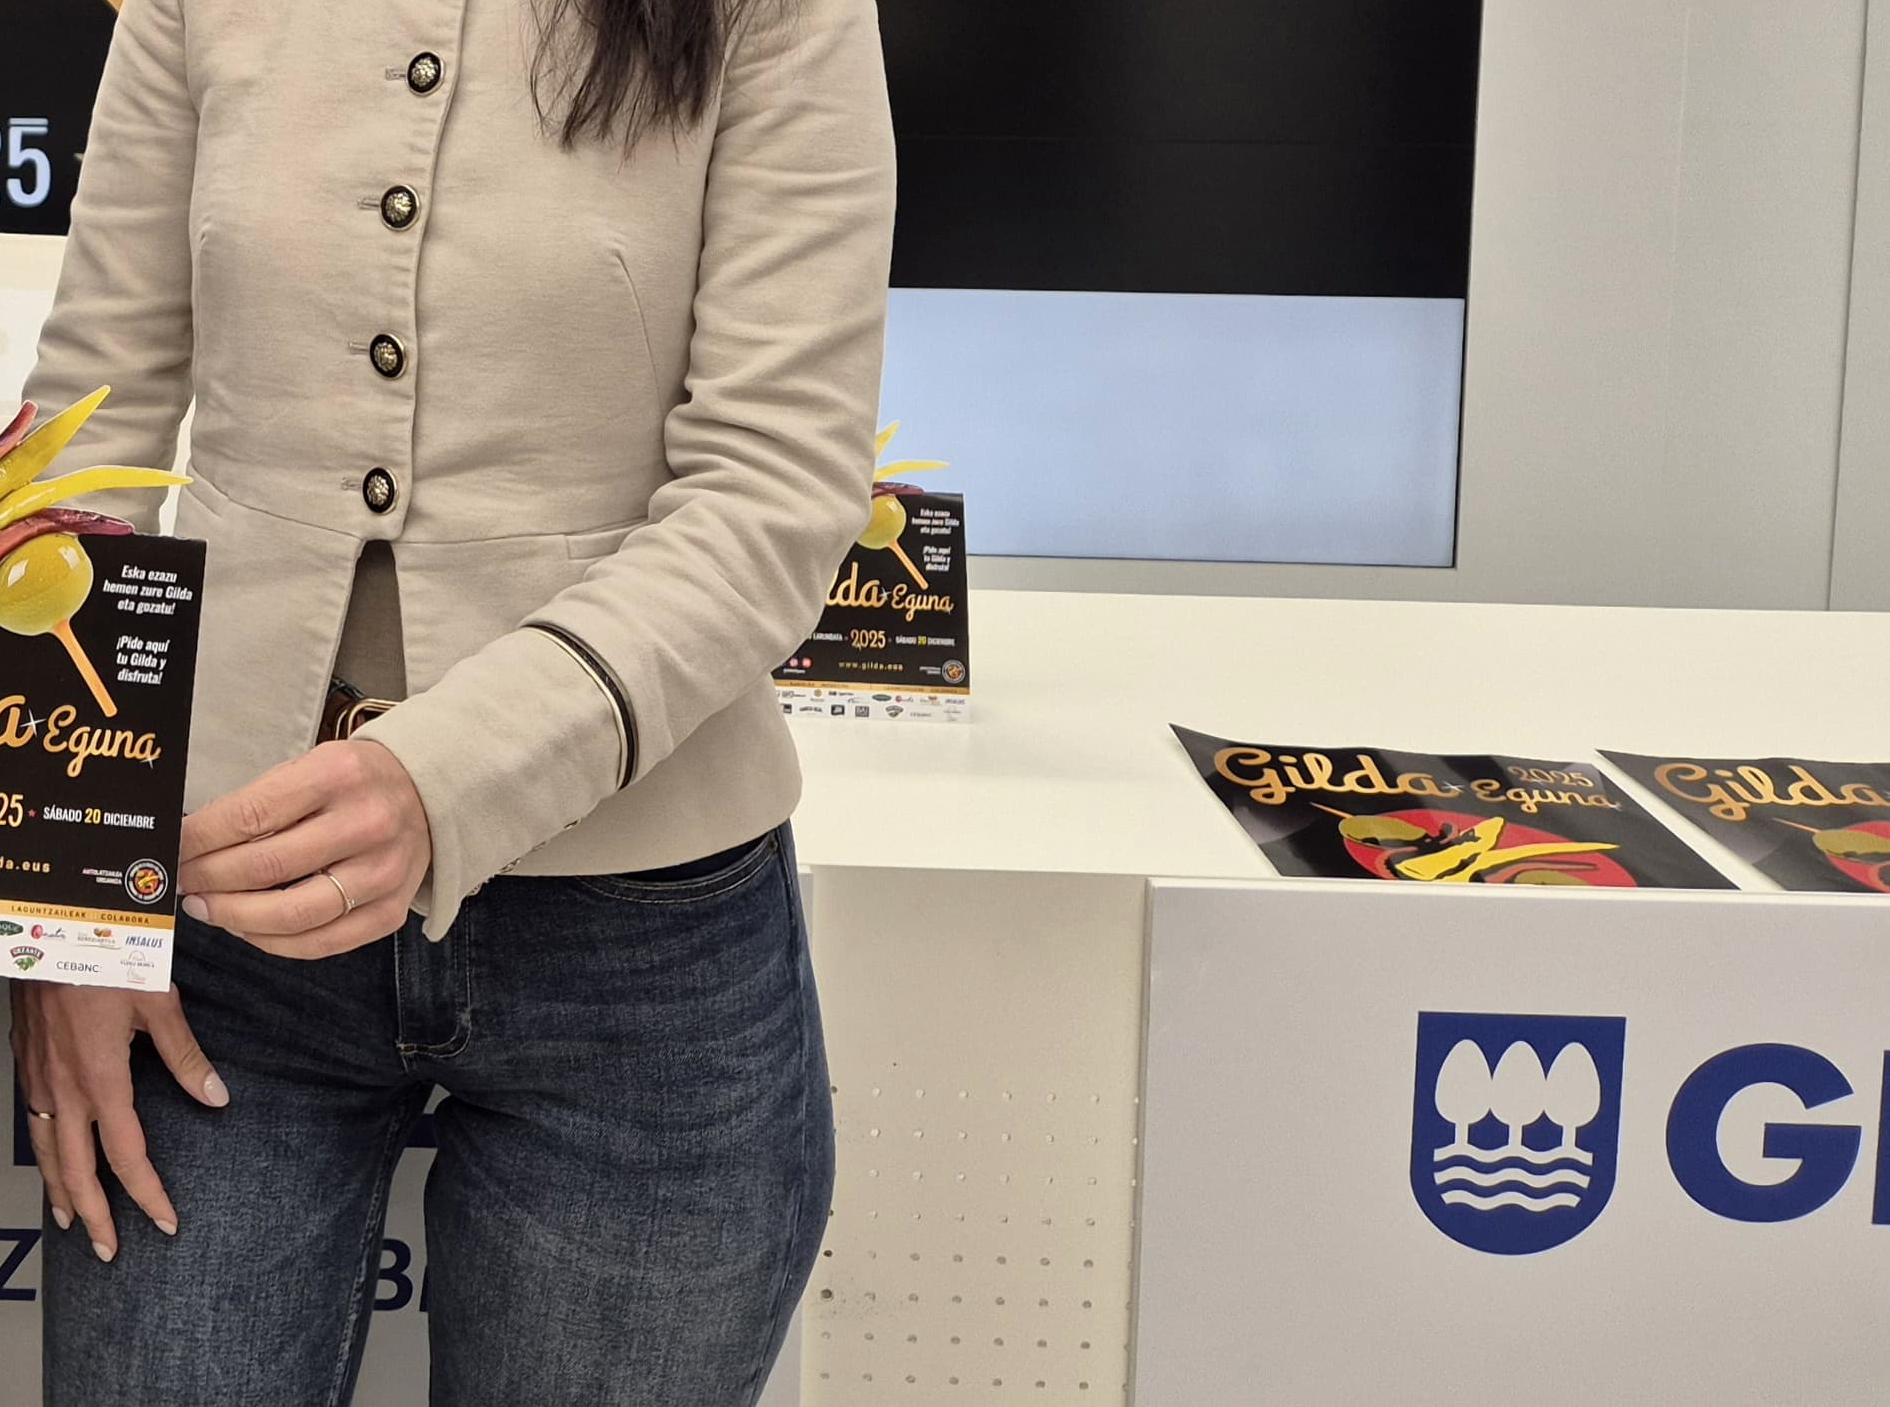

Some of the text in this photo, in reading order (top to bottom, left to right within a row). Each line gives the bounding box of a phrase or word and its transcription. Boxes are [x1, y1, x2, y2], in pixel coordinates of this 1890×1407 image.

[121, 564, 178, 583] Eska ezazu
[102, 579, 193, 601] hemen zure Gilda
[117, 599, 176, 615] eta gozatu!
[890, 583, 954, 622] Eguna
[116, 635, 170, 654] ¡Pide aquí
[850, 628, 886, 649] 2025
[116, 652, 167, 671] tu Gilda y
[117, 668, 163, 685] disfruta!
[42, 704, 162, 778] Eguna
[1213, 746, 1618, 814] Gilda Eguna
[1507, 765, 1594, 788] 2025
[1653, 761, 1890, 822] Gilda
[43, 804, 83, 823] SÁBADO
[84, 807, 102, 825] 20
[103, 812, 156, 830] DICIEMBRE
[100, 913, 150, 925] COLABORA
[125, 935, 164, 949] INSALUS
